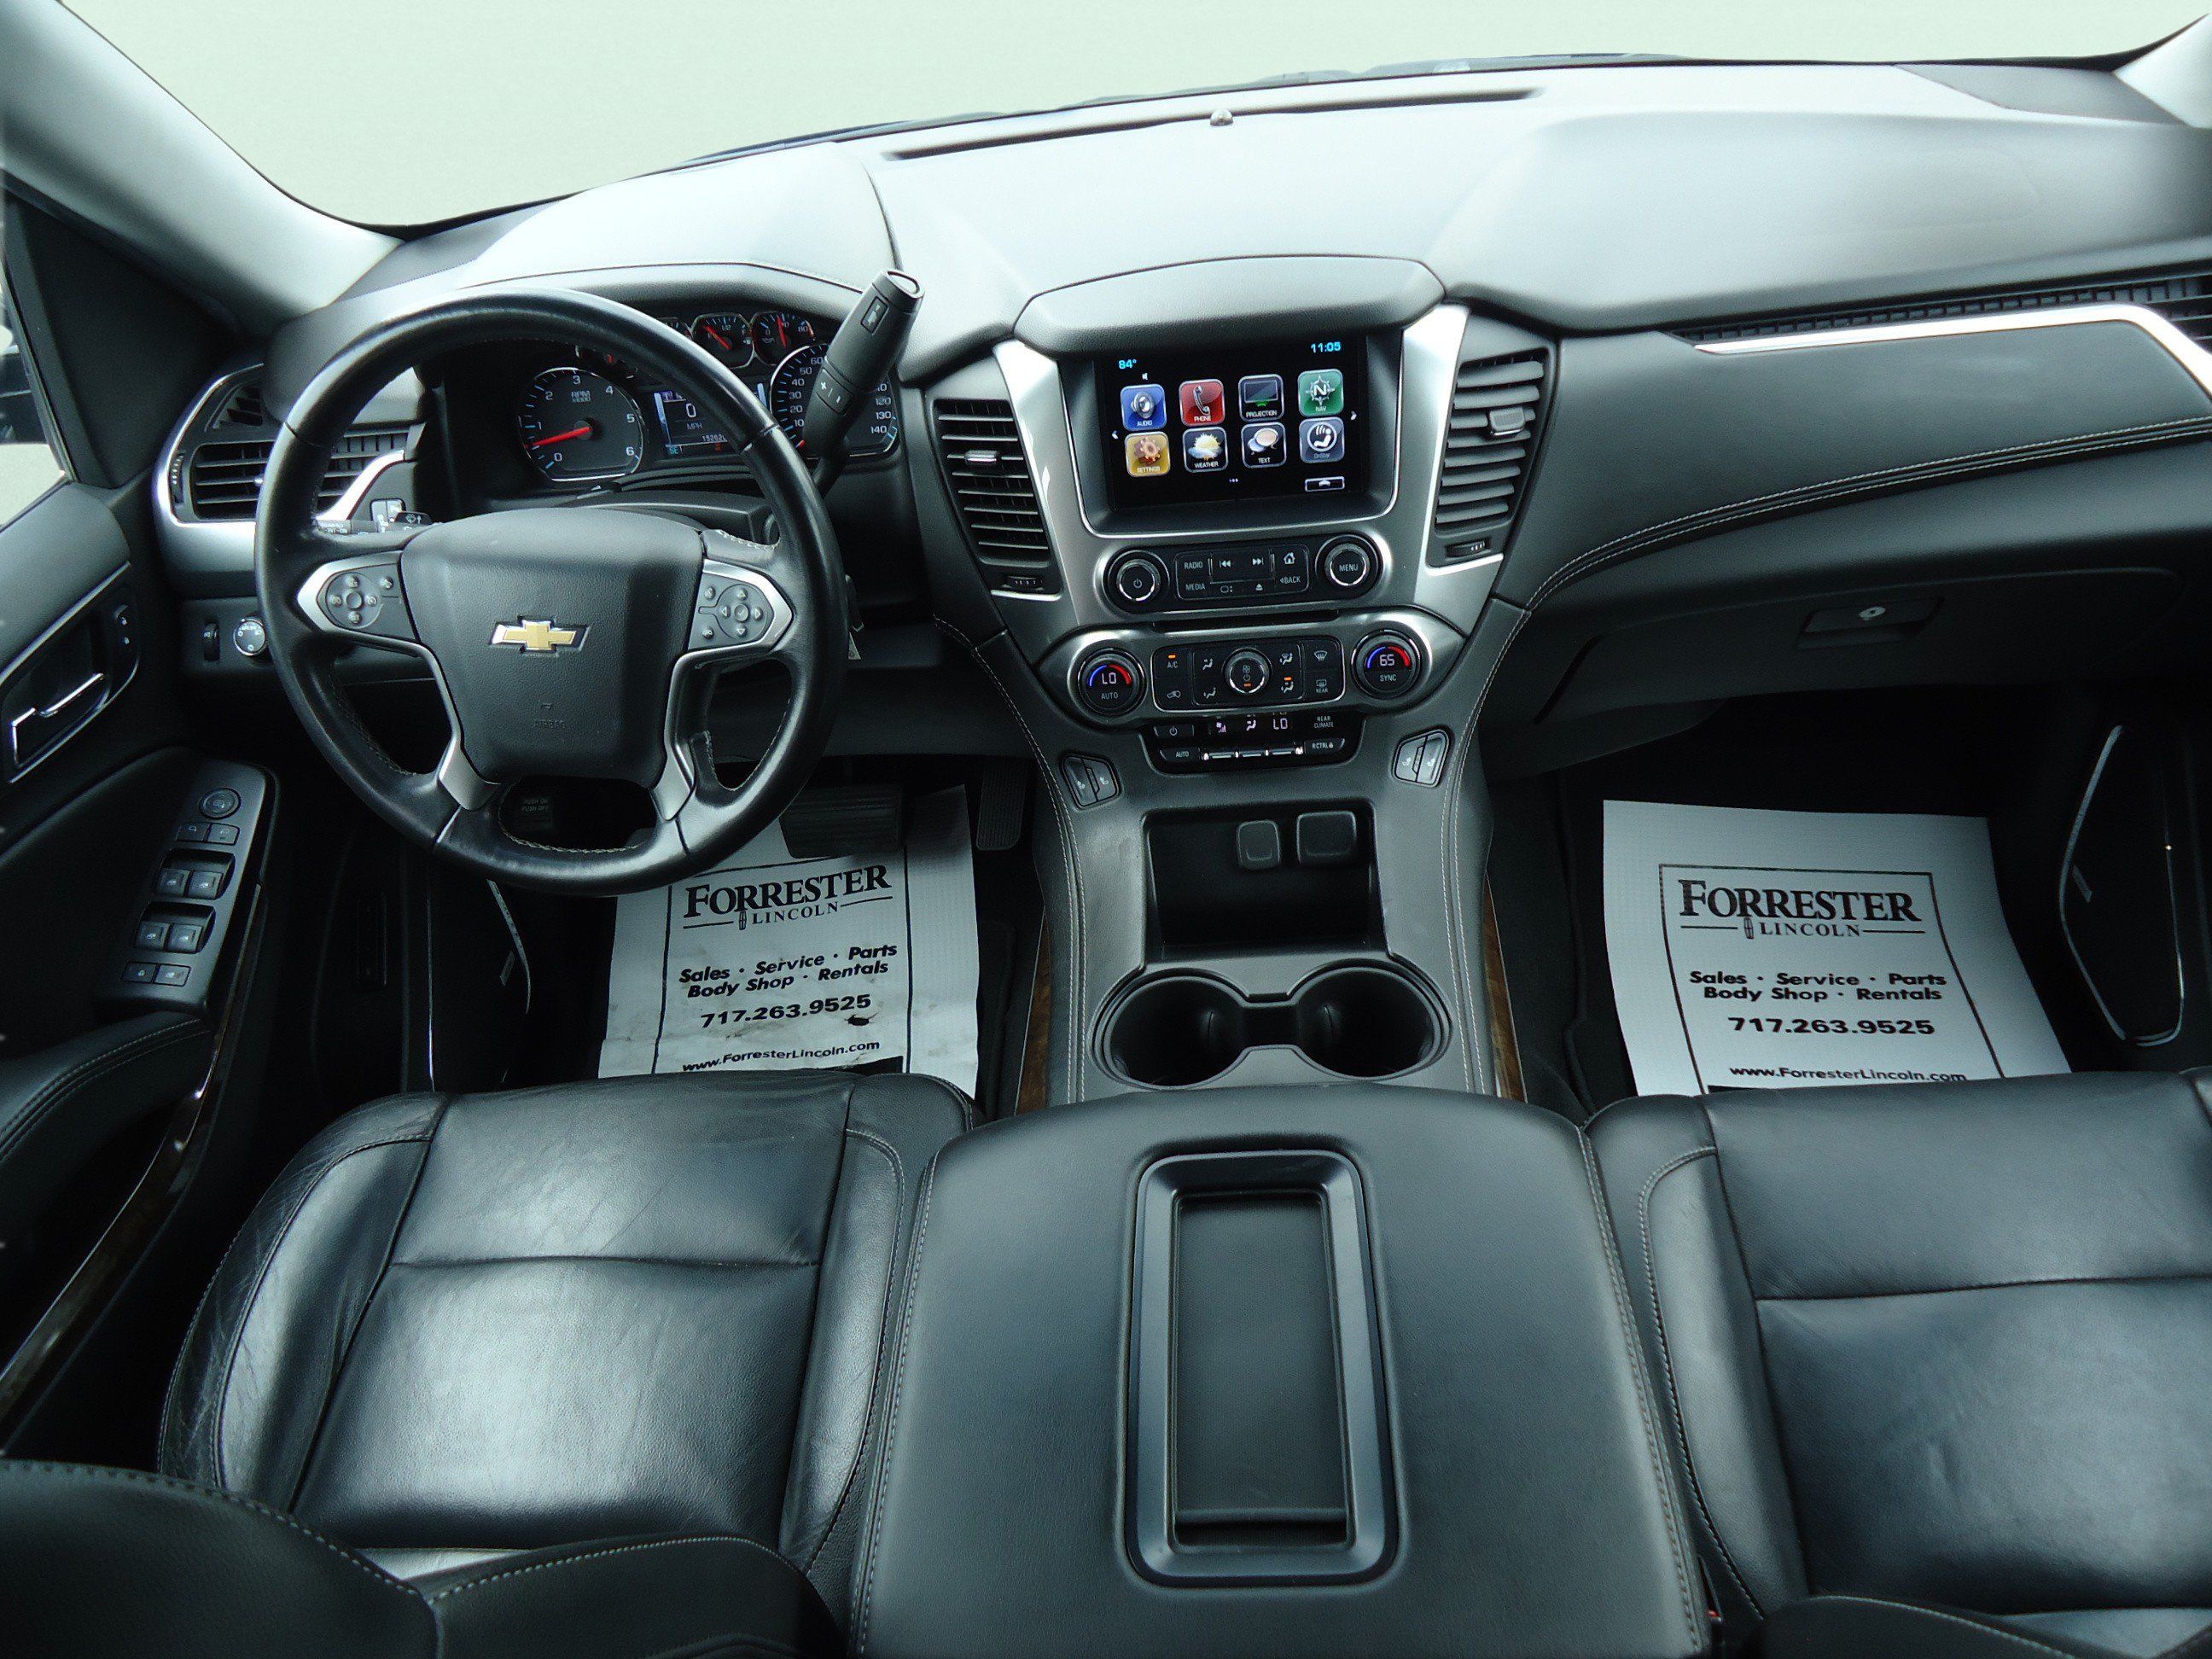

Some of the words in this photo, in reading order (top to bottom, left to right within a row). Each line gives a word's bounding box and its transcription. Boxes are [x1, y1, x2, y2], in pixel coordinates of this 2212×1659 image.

[1311, 341, 1342, 353] 11:05
[811, 356, 824, 365] 60
[1118, 358, 1138, 370] 84°
[799, 366, 812, 375] 50
[572, 375, 581, 385] 3
[791, 378, 805, 387] 40
[605, 385, 614, 395] 4
[789, 391, 802, 399] 30
[544, 391, 554, 401] 2
[876, 397, 892, 405] 120
[685, 403, 696, 418] 0
[789, 405, 803, 413] 20
[626, 413, 635, 423] 5
[876, 410, 892, 420] 130
[795, 419, 805, 428] 10
[870, 425, 888, 434] 140
[554, 452, 562, 462] 0
[626, 446, 635, 457] 6
[1338, 563, 1359, 572] MENU
[1284, 575, 1301, 584] BACK
[1185, 583, 1206, 591] MEDIA
[1379, 654, 1396, 667] 65
[1101, 672, 1117, 684] LO
[1101, 691, 1119, 700] AUTO
[1272, 718, 1289, 730] LO
[683, 864, 893, 919] FORRESTER
[1677, 878, 1923, 923] FORRESTER
[752, 901, 839, 925] LINCOLN
[1760, 922, 1860, 938] LINCOLN
[678, 966, 731, 984] Sales
[754, 954, 825, 975] Service
[848, 944, 898, 961] Parts
[687, 982, 740, 998] Body
[745, 975, 795, 992] Shop
[818, 960, 889, 981] Rentals
[1689, 970, 1748, 984] Sales
[1776, 972, 1860, 987] Service
[1888, 973, 1947, 987] Parts
[1703, 987, 1763, 1002] Body
[1771, 987, 1829, 1003] Shop
[1856, 987, 1943, 1001] Rentals
[701, 994, 872, 1028] 717.263.9525
[1727, 1016, 1936, 1035] 717.263.9525
[682, 1040, 881, 1073] www.ForresterLincoln.com
[1729, 1067, 1967, 1082] www.ForresterLincoln.com
